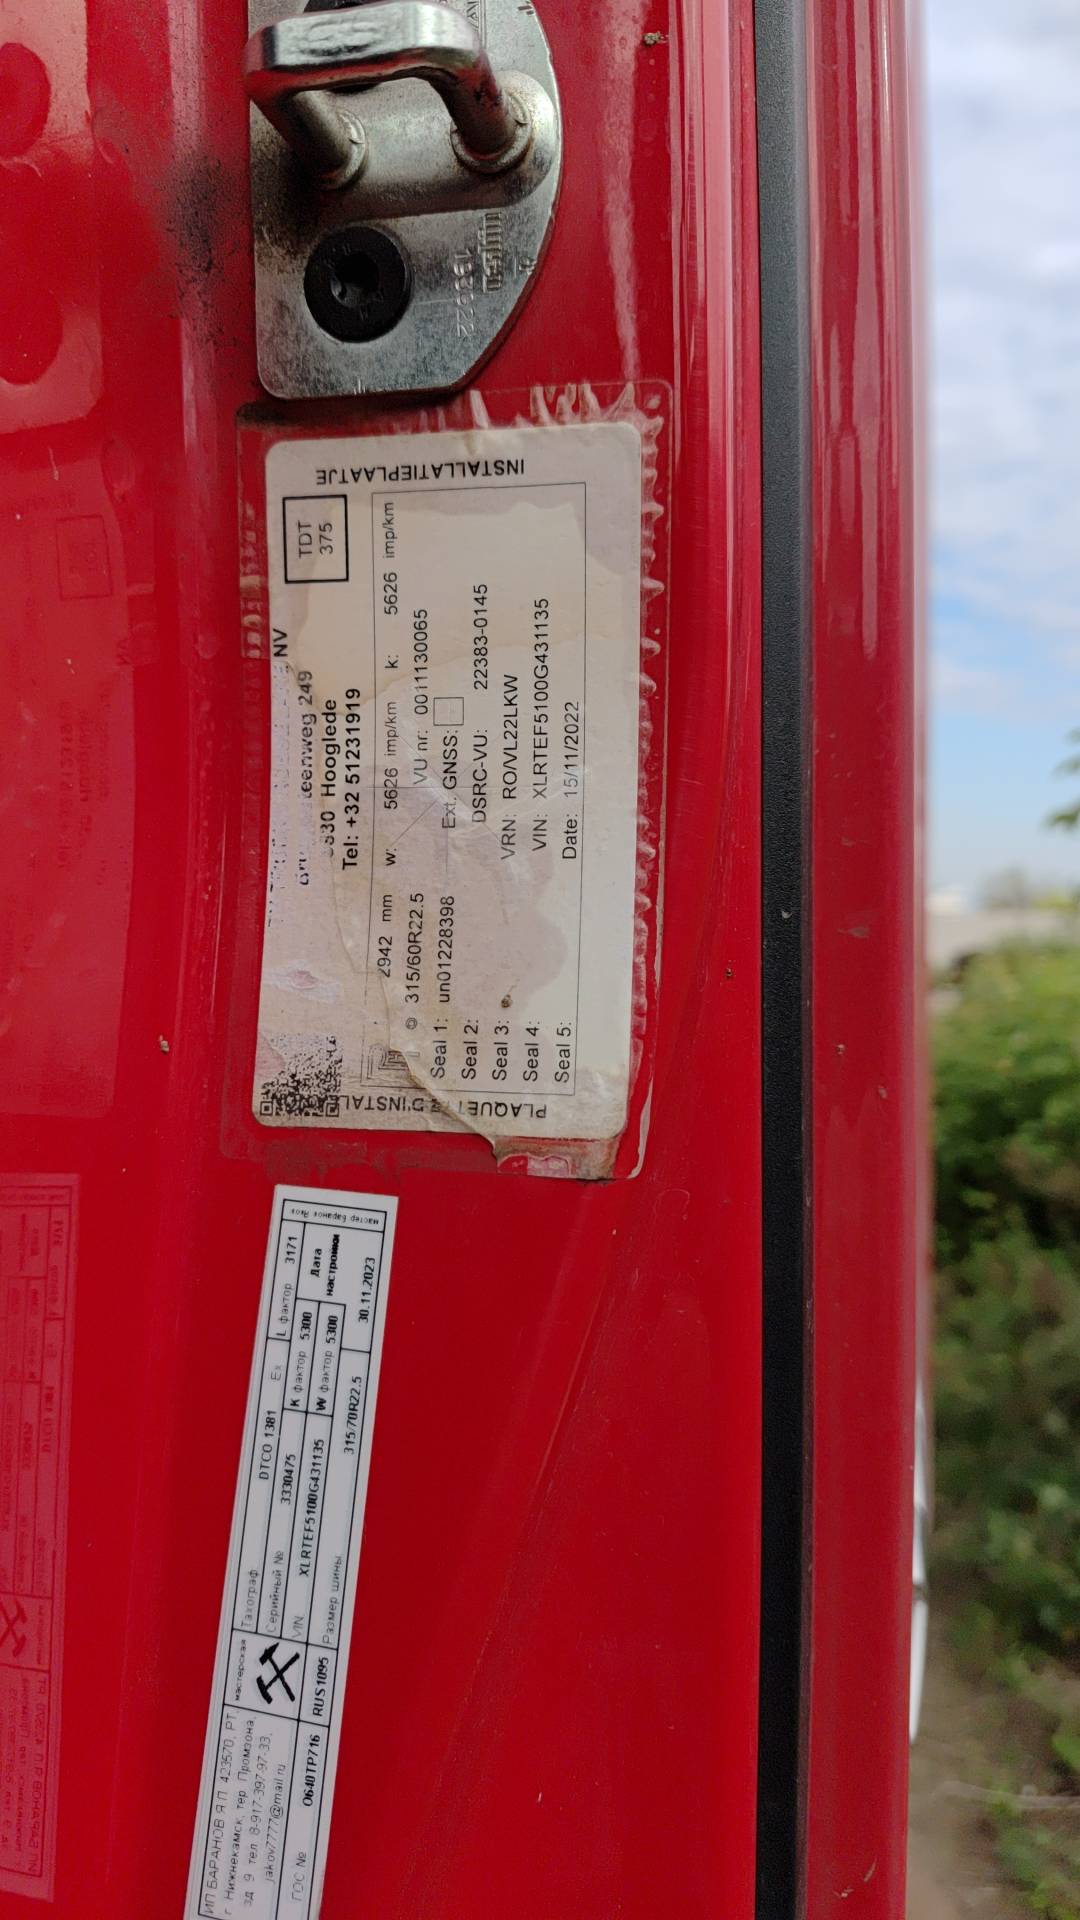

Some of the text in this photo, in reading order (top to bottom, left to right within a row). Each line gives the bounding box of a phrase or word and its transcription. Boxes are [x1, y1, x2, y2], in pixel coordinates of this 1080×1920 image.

[316, 458, 524, 484] INSTALLATIEPLAATJE
[298, 519, 312, 558] TDT
[318, 522, 333, 554] 375
[273, 628, 288, 657] NV
[298, 670, 312, 705] 249
[414, 608, 428, 784] VU nr: 0011130065
[472, 584, 488, 822] DSRC-VU: 22383-0145
[320, 699, 340, 796] Hooglede
[377, 502, 400, 978] 2942 mm w: 5626 imp/km k: 5626 imp/km
[532, 598, 548, 851] VIN: XLRTEF5100G431135
[342, 688, 360, 870] Tel: +32 51231919
[442, 729, 458, 828] Ext. GNSS:
[501, 674, 518, 860] VRN: RO/VL22LKW
[562, 701, 579, 858] Date: 15/11/2022
[405, 892, 424, 1002] 315/60R22.5
[430, 895, 454, 1078] Seal 1: un01228398
[461, 1019, 478, 1080] Seal 2:
[492, 1020, 509, 1080] Seal 3:
[522, 1021, 540, 1082] Seal 4:
[554, 1022, 572, 1082] Seal 5:
[430, 1098, 546, 1118] PLAQUETE
[284, 1236, 298, 1264] 3171
[310, 1248, 322, 1278] Дата
[278, 1282, 293, 1324] фактор
[358, 1256, 376, 1323] 30.11.2023
[292, 1350, 306, 1392] фактор
[300, 1311, 312, 1340] 5300
[316, 1314, 338, 1410] W фактор 5300
[264, 1410, 276, 1438] 1381
[343, 1376, 362, 1454] 315/70R22.5
[258, 1443, 272, 1480] DTCO
[265, 1569, 282, 1632] Серийный
[280, 1453, 296, 1504] 3330475
[292, 1438, 325, 1638] VIN XLRTEF5100G431135
[240, 1569, 259, 1627] Тахограф
[322, 1554, 342, 1644] Размер шины
[234, 1638, 247, 1701] мастерская
[206, 1818, 225, 1889] БАРАНОВ
[244, 1873, 254, 1882] 9
[204, 1892, 216, 1914] ИП
[292, 1872, 306, 1901] ГОС
